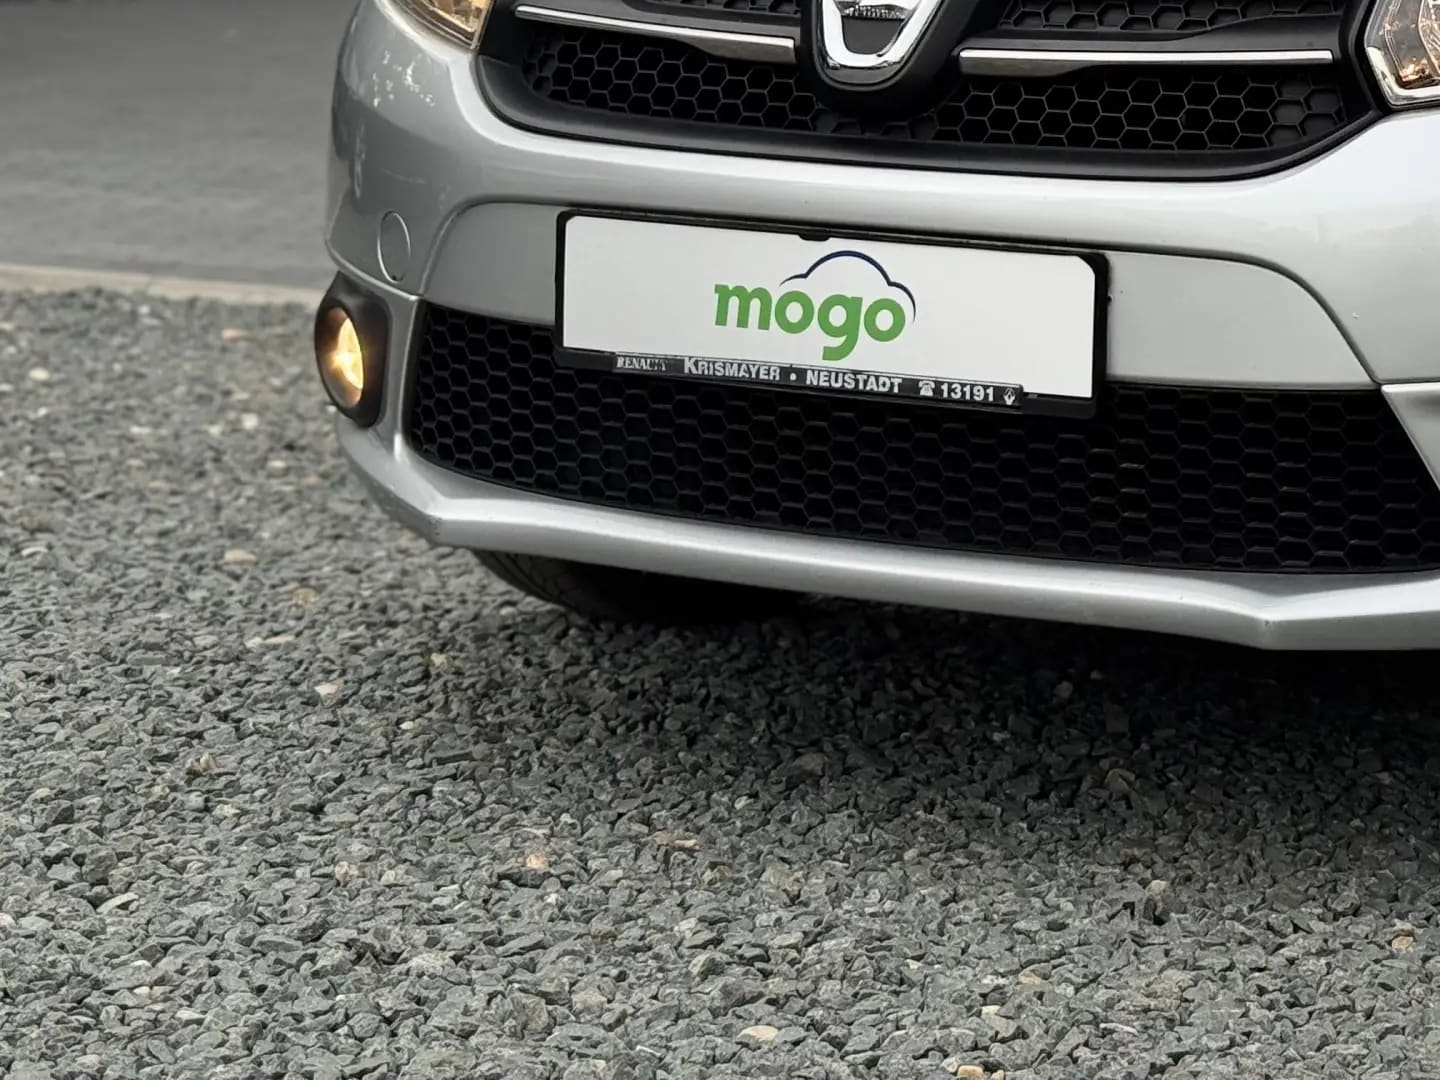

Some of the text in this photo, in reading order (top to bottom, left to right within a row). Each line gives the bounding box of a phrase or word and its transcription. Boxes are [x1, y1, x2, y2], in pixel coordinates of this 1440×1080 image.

[713, 282, 906, 361] mogo
[805, 369, 903, 394] NEUSTADT
[940, 382, 995, 402] 13191
